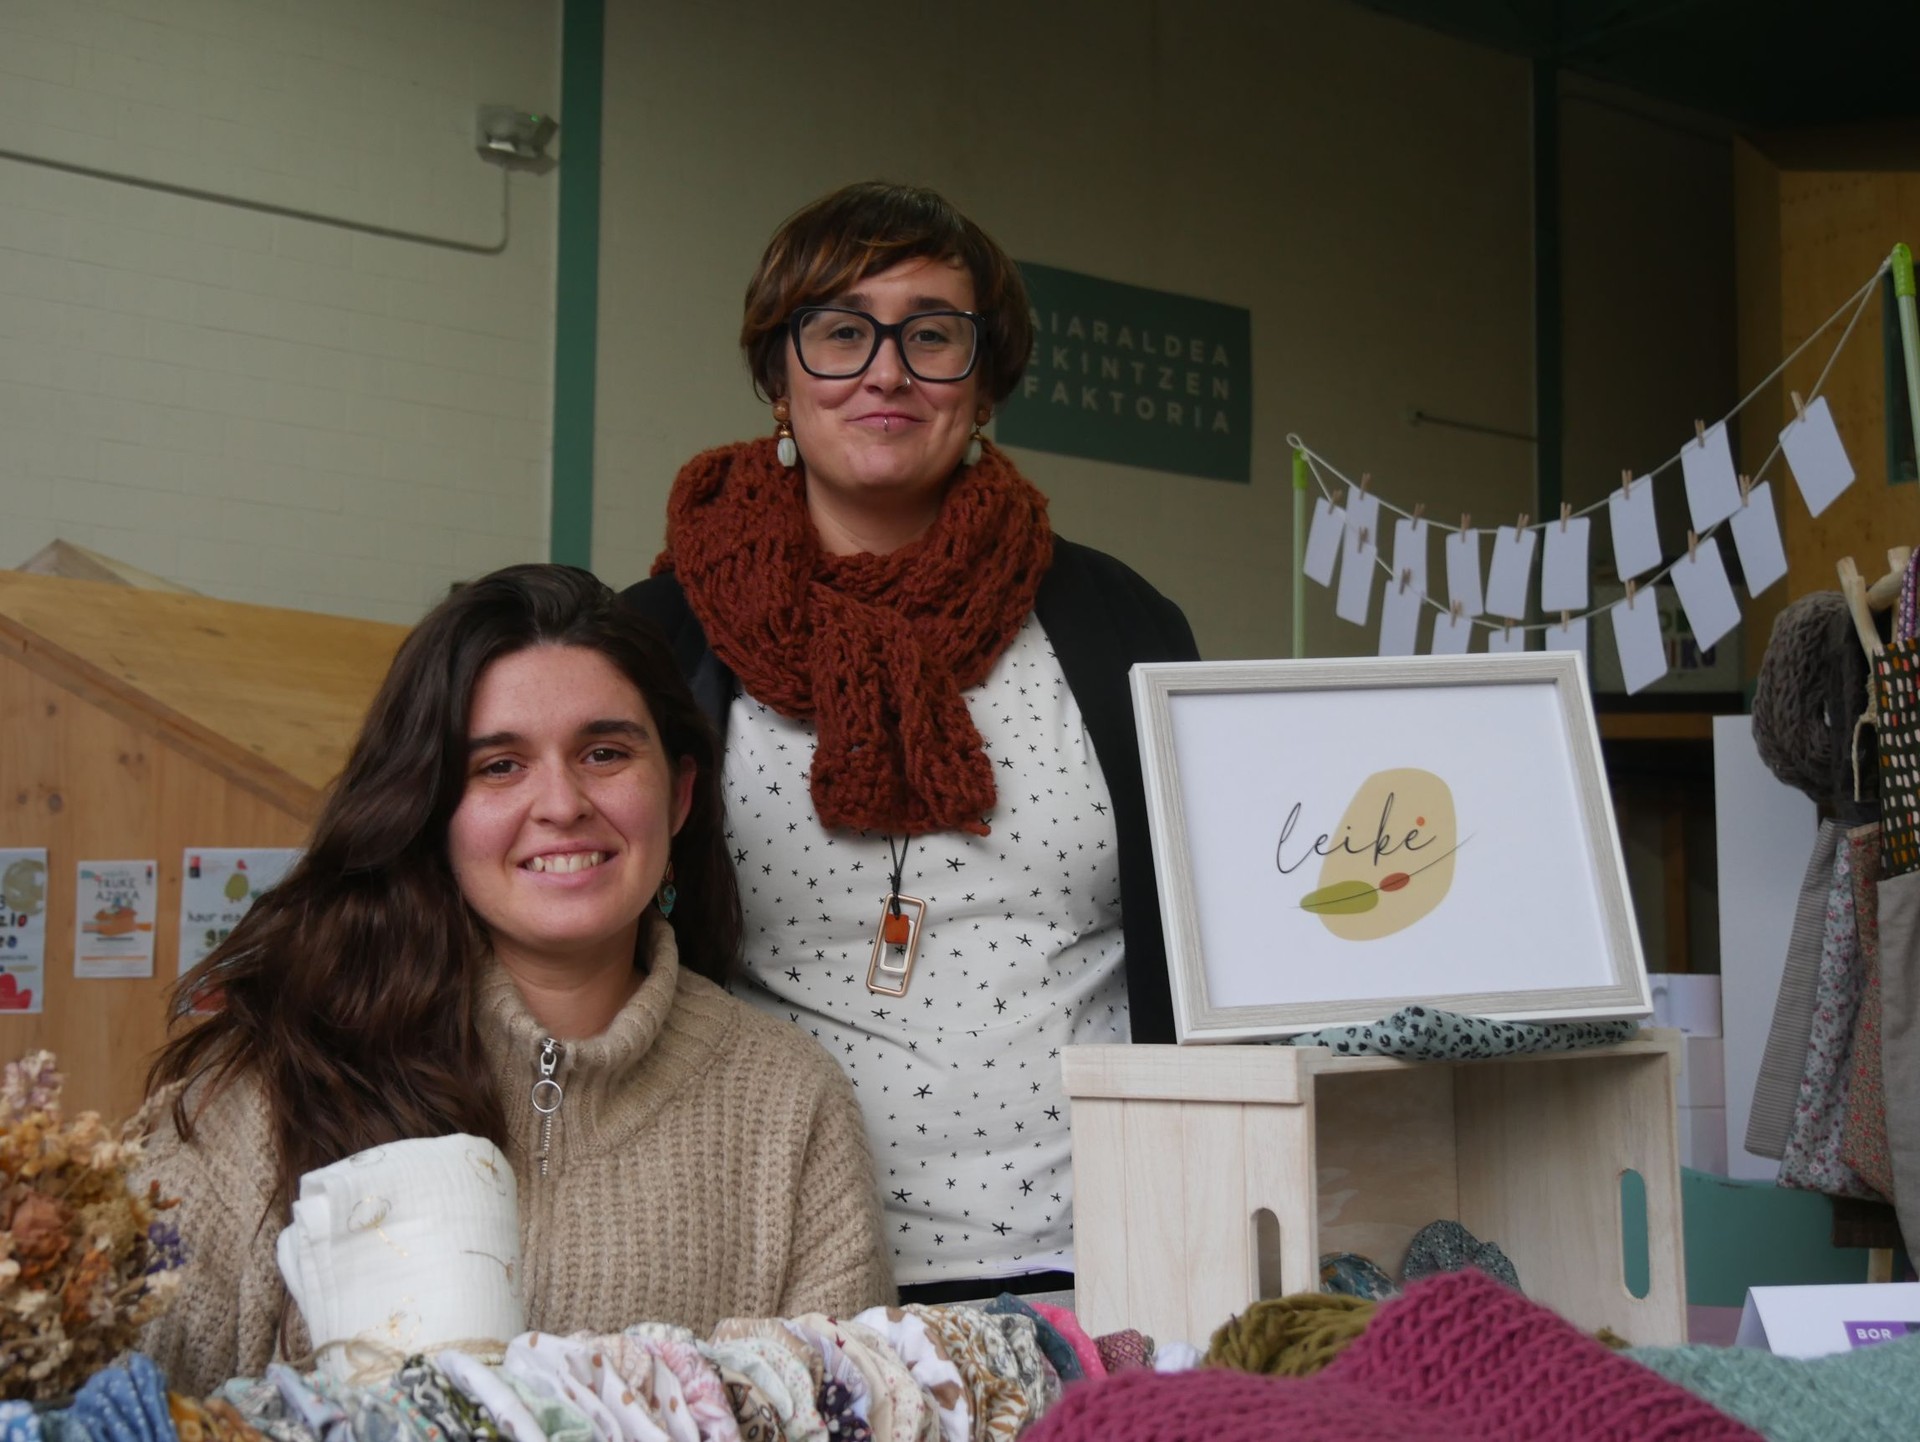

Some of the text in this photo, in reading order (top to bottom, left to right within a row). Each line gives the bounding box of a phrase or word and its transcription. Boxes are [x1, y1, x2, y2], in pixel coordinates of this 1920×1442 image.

[1028, 307, 1230, 369] AIARALDEA
[1027, 341, 1230, 401] EKINTZEN
[1023, 374, 1231, 435] FAKTORIA
[1276, 791, 1438, 875] leike
[1855, 1327, 1893, 1340] BOR
